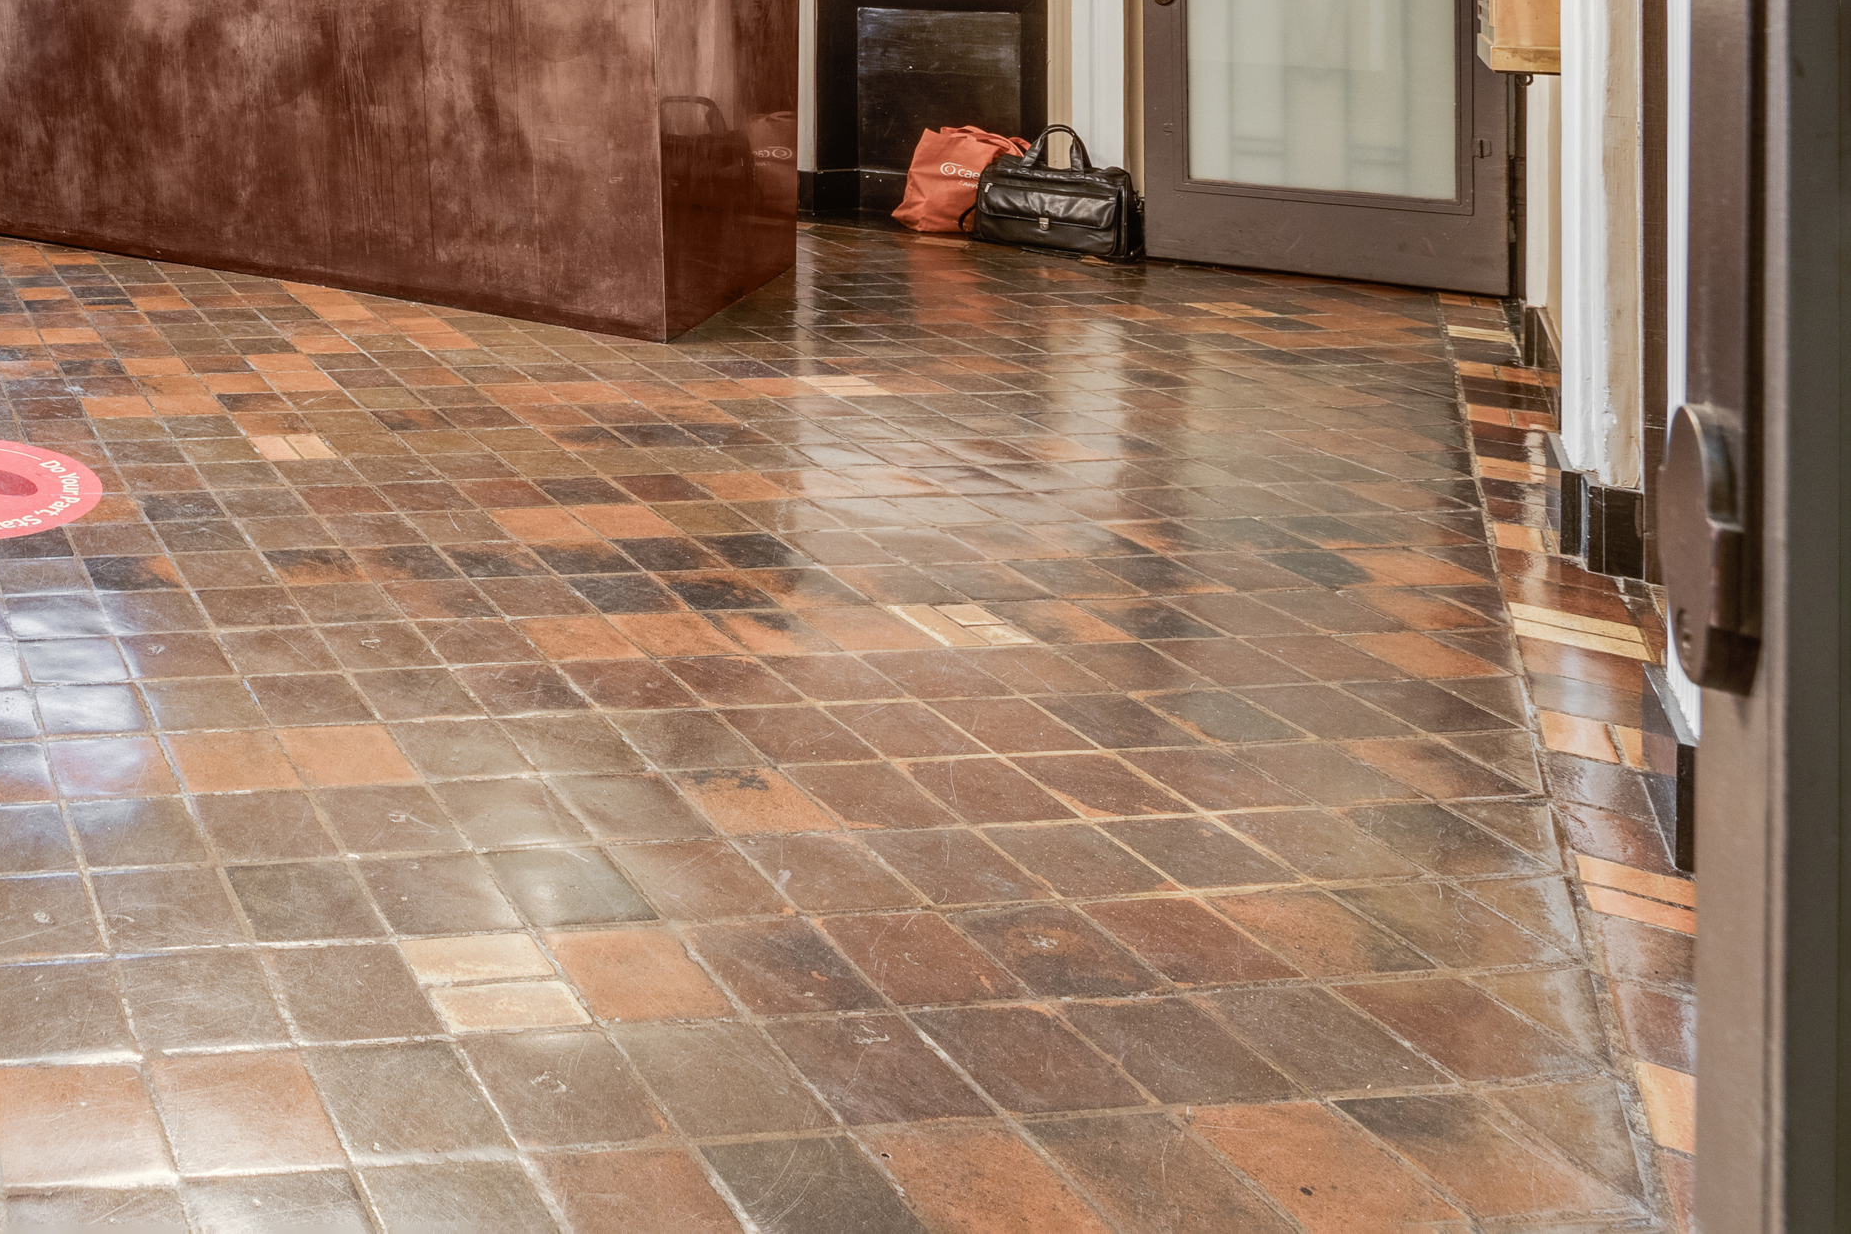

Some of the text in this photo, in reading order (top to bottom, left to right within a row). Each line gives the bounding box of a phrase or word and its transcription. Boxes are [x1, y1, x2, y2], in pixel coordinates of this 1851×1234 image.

[38, 459, 67, 473] Do
[57, 472, 81, 496] Your
[33, 494, 81, 517] Part,
